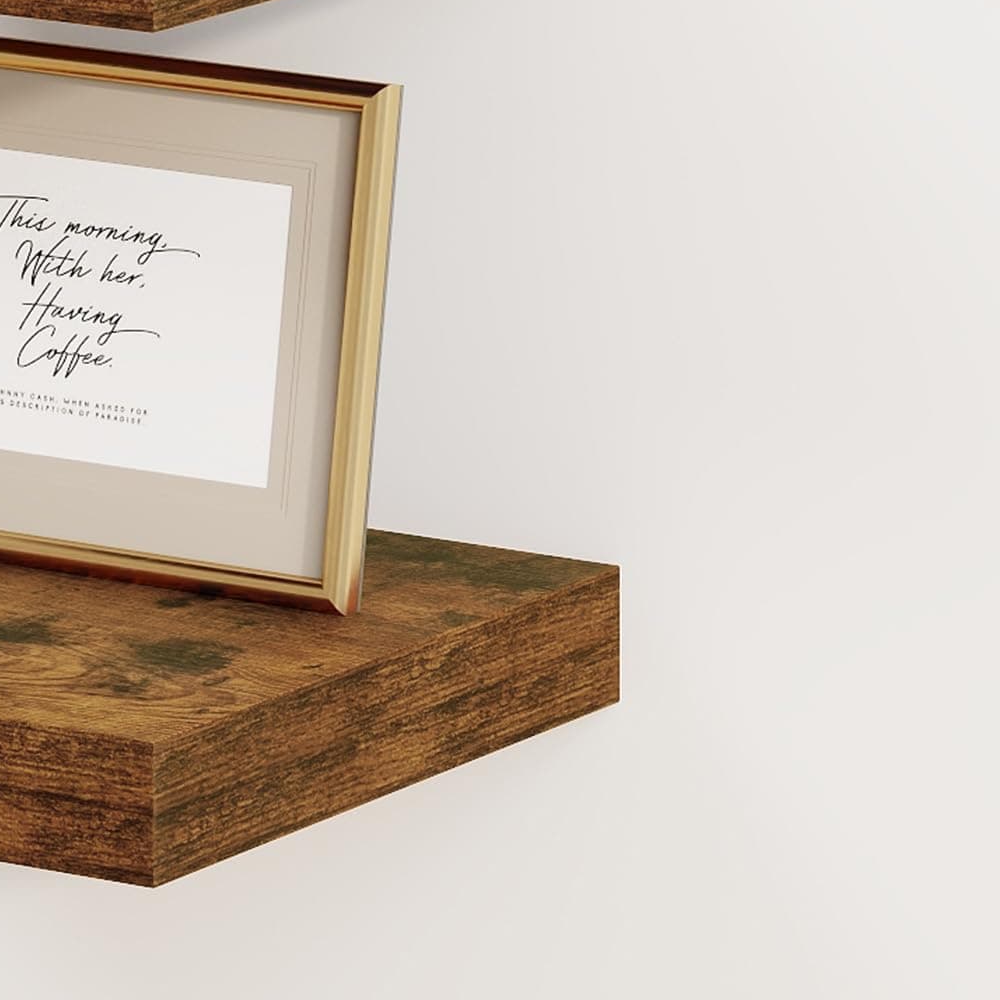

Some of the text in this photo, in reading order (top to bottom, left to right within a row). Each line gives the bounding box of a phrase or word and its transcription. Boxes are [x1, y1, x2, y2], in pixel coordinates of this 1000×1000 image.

[15, 234, 93, 287] With
[64, 221, 201, 266] morning,
[18, 281, 161, 347] Having
[16, 324, 113, 379] Coffee.
[9, 399, 74, 416] DESCRIPTION
[78, 408, 91, 417] OF
[63, 397, 90, 408] WHEN
[95, 402, 126, 413] ASKED
[130, 407, 147, 416] FOR
